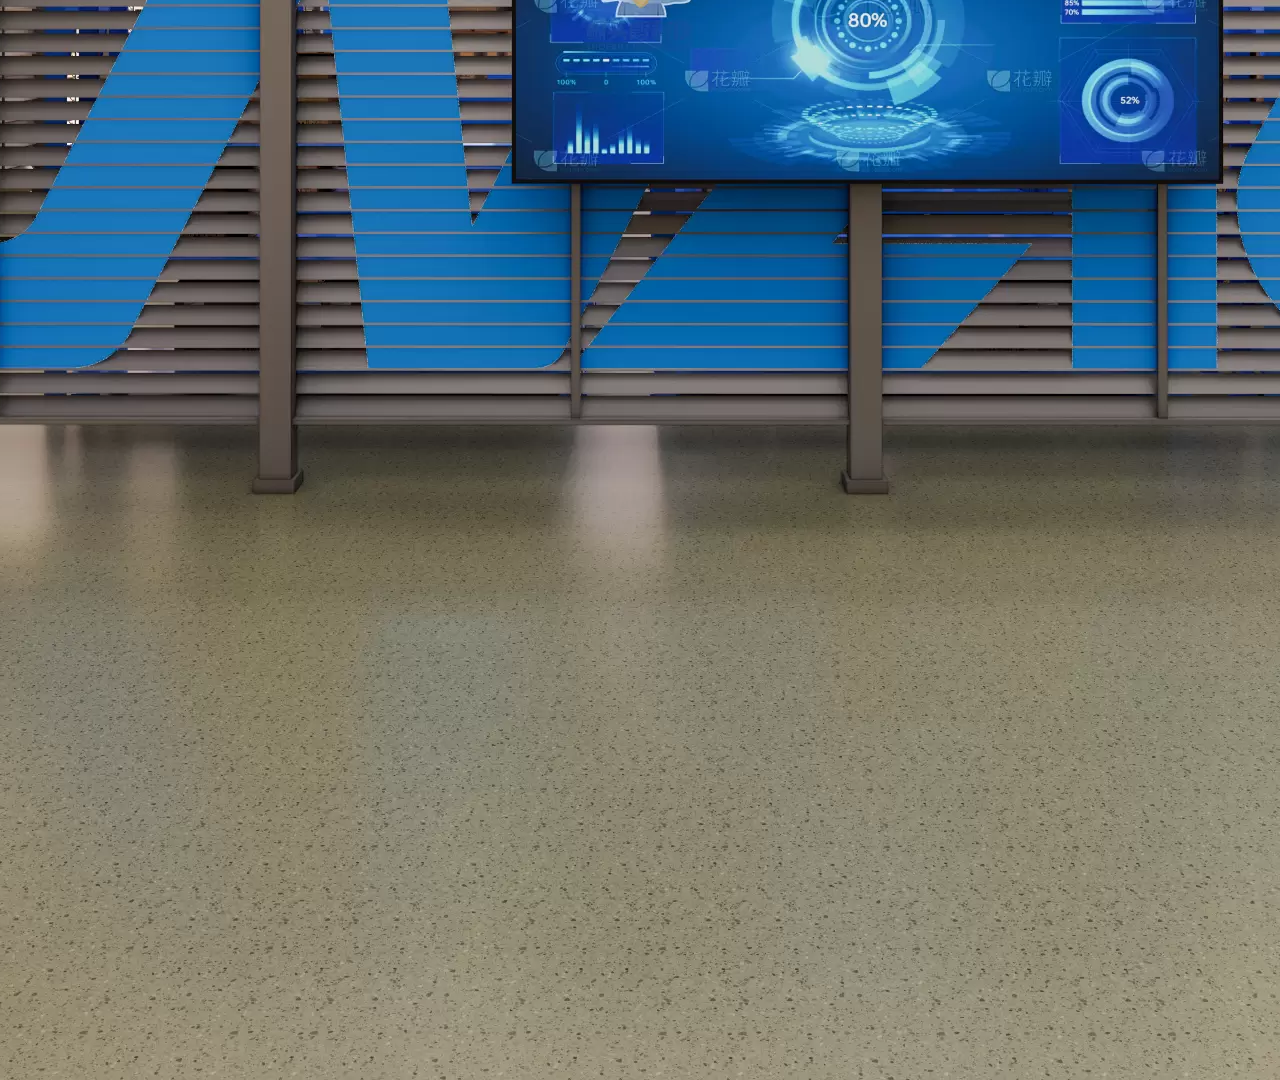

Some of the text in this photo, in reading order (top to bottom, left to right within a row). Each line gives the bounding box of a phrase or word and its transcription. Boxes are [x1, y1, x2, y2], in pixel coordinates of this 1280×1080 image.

[848, 12, 888, 28] 80%
[711, 69, 751, 87] 花瓣
[1013, 69, 1053, 87] 花瓣
[1120, 96, 1140, 105] 52%
